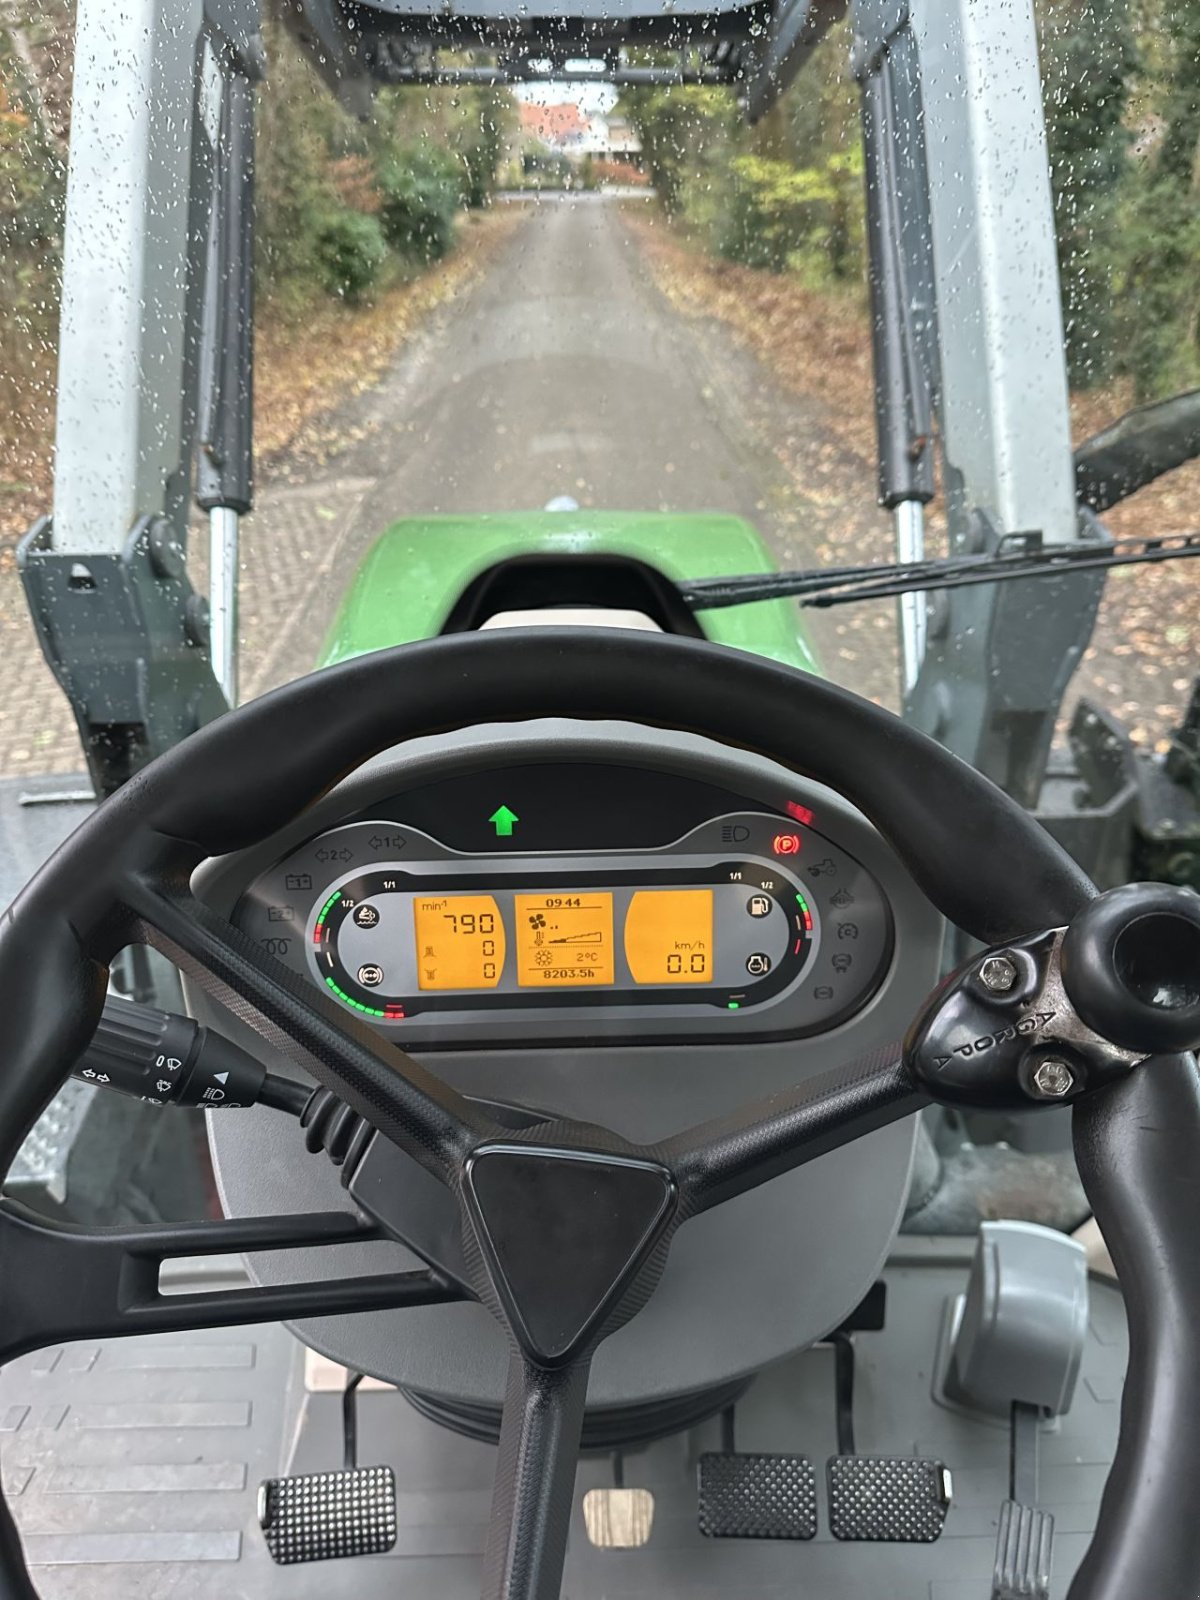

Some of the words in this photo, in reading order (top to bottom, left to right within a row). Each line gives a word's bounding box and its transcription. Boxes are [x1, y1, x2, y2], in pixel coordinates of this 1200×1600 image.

[729, 872, 742, 880] 1/1
[383, 881, 396, 889] 1/1
[761, 881, 774, 890] 1/2
[341, 900, 354, 908] 1/2
[443, 913, 494, 934] 790
[483, 940, 494, 956] 0
[674, 940, 705, 951] km/h
[576, 952, 599, 962] 2°C
[667, 953, 705, 973] 0.0
[484, 963, 495, 979] 0
[543, 968, 595, 979] 8203.5h
[932, 1010, 1057, 1071] AGROPA
